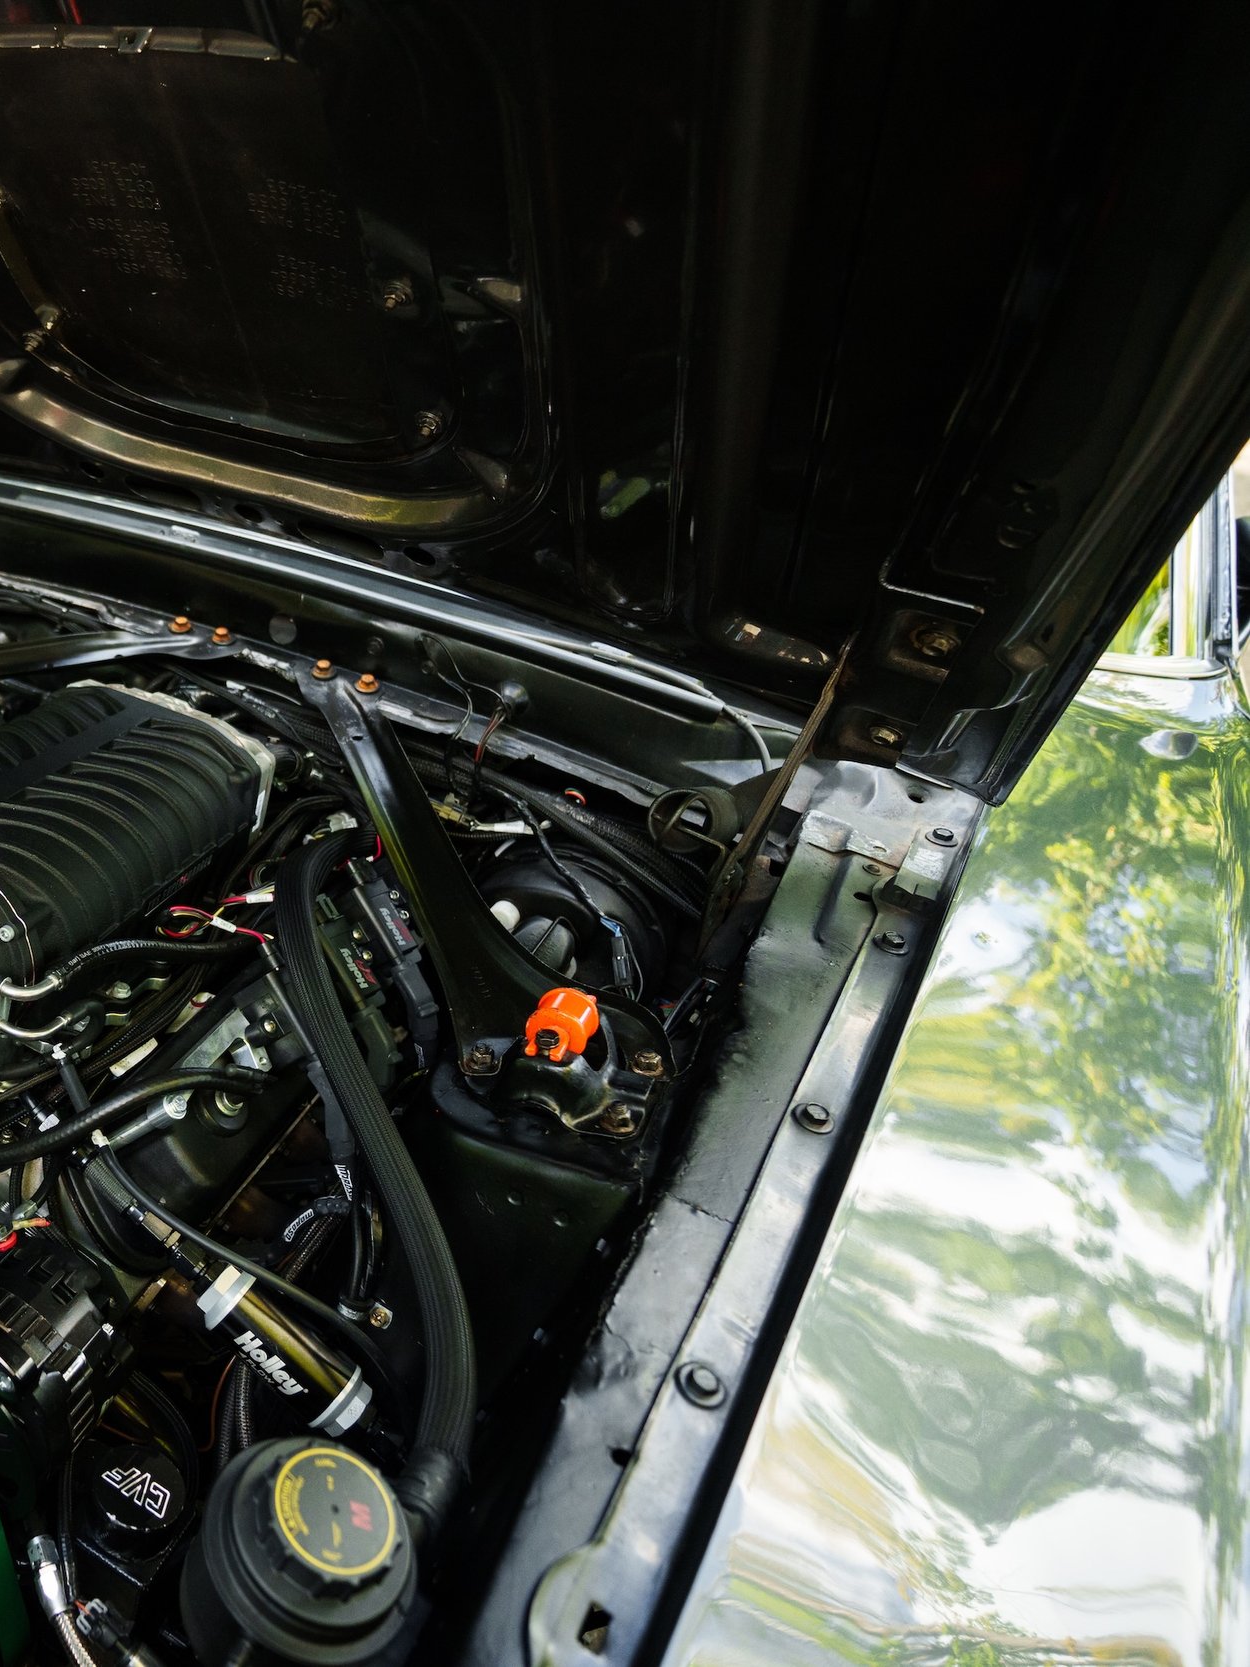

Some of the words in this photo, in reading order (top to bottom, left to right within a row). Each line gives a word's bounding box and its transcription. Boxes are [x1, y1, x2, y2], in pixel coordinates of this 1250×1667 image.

[378, 907, 407, 946] Holley
[339, 947, 369, 989] Holley
[233, 1330, 305, 1396] Holley
[101, 1466, 171, 1519] CVF
